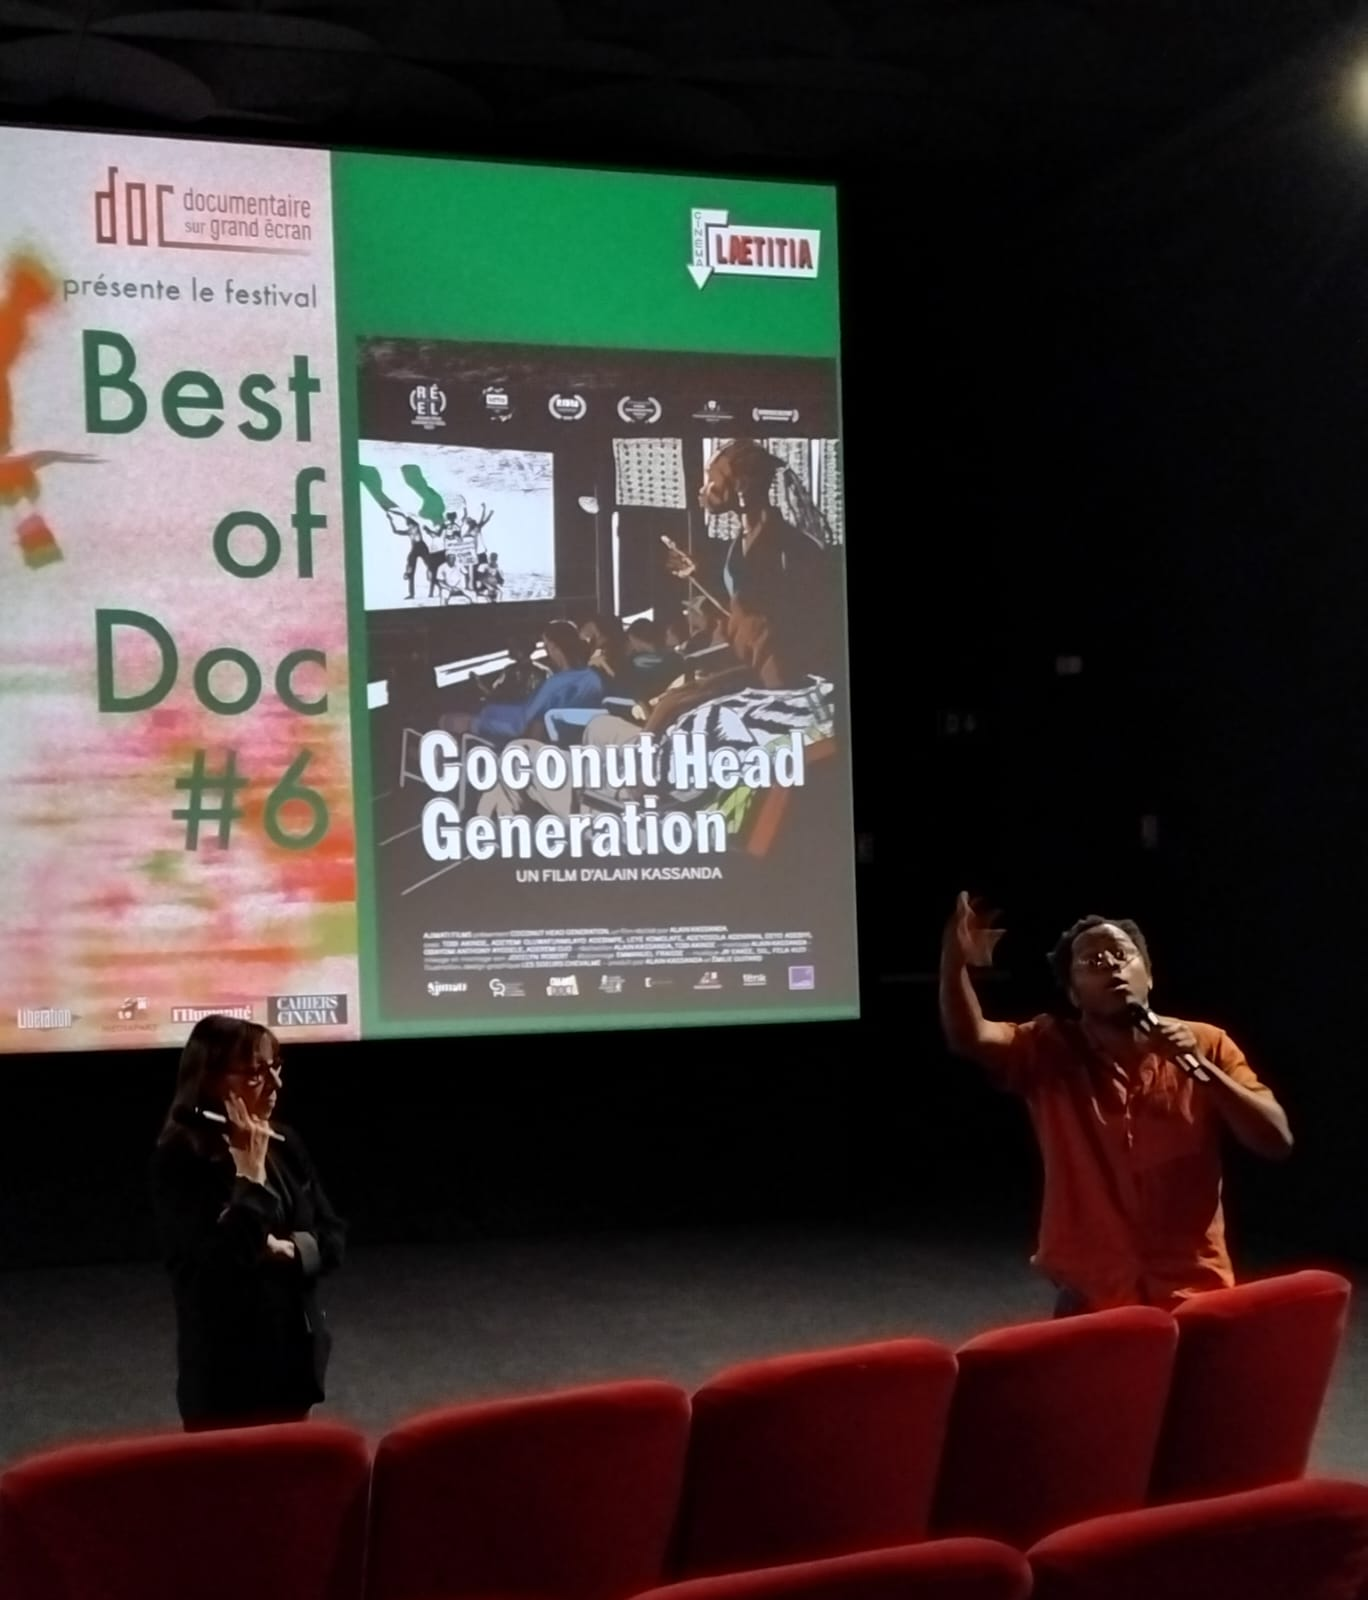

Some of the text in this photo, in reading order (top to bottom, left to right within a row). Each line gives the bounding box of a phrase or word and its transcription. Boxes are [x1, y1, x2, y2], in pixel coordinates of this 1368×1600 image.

[183, 187, 312, 219] documentaire
[184, 217, 312, 242] sur grand écran
[63, 273, 317, 308] présente le festival
[82, 328, 321, 443] Best
[212, 466, 328, 579] of
[95, 608, 329, 717] Doc
[419, 729, 806, 793] Coconut Head
[172, 748, 330, 851] #6
[421, 796, 728, 861] Generation
[516, 867, 723, 882] UN FILM D'ALAIN KASSANDA
[277, 995, 338, 1011] CAHIERS
